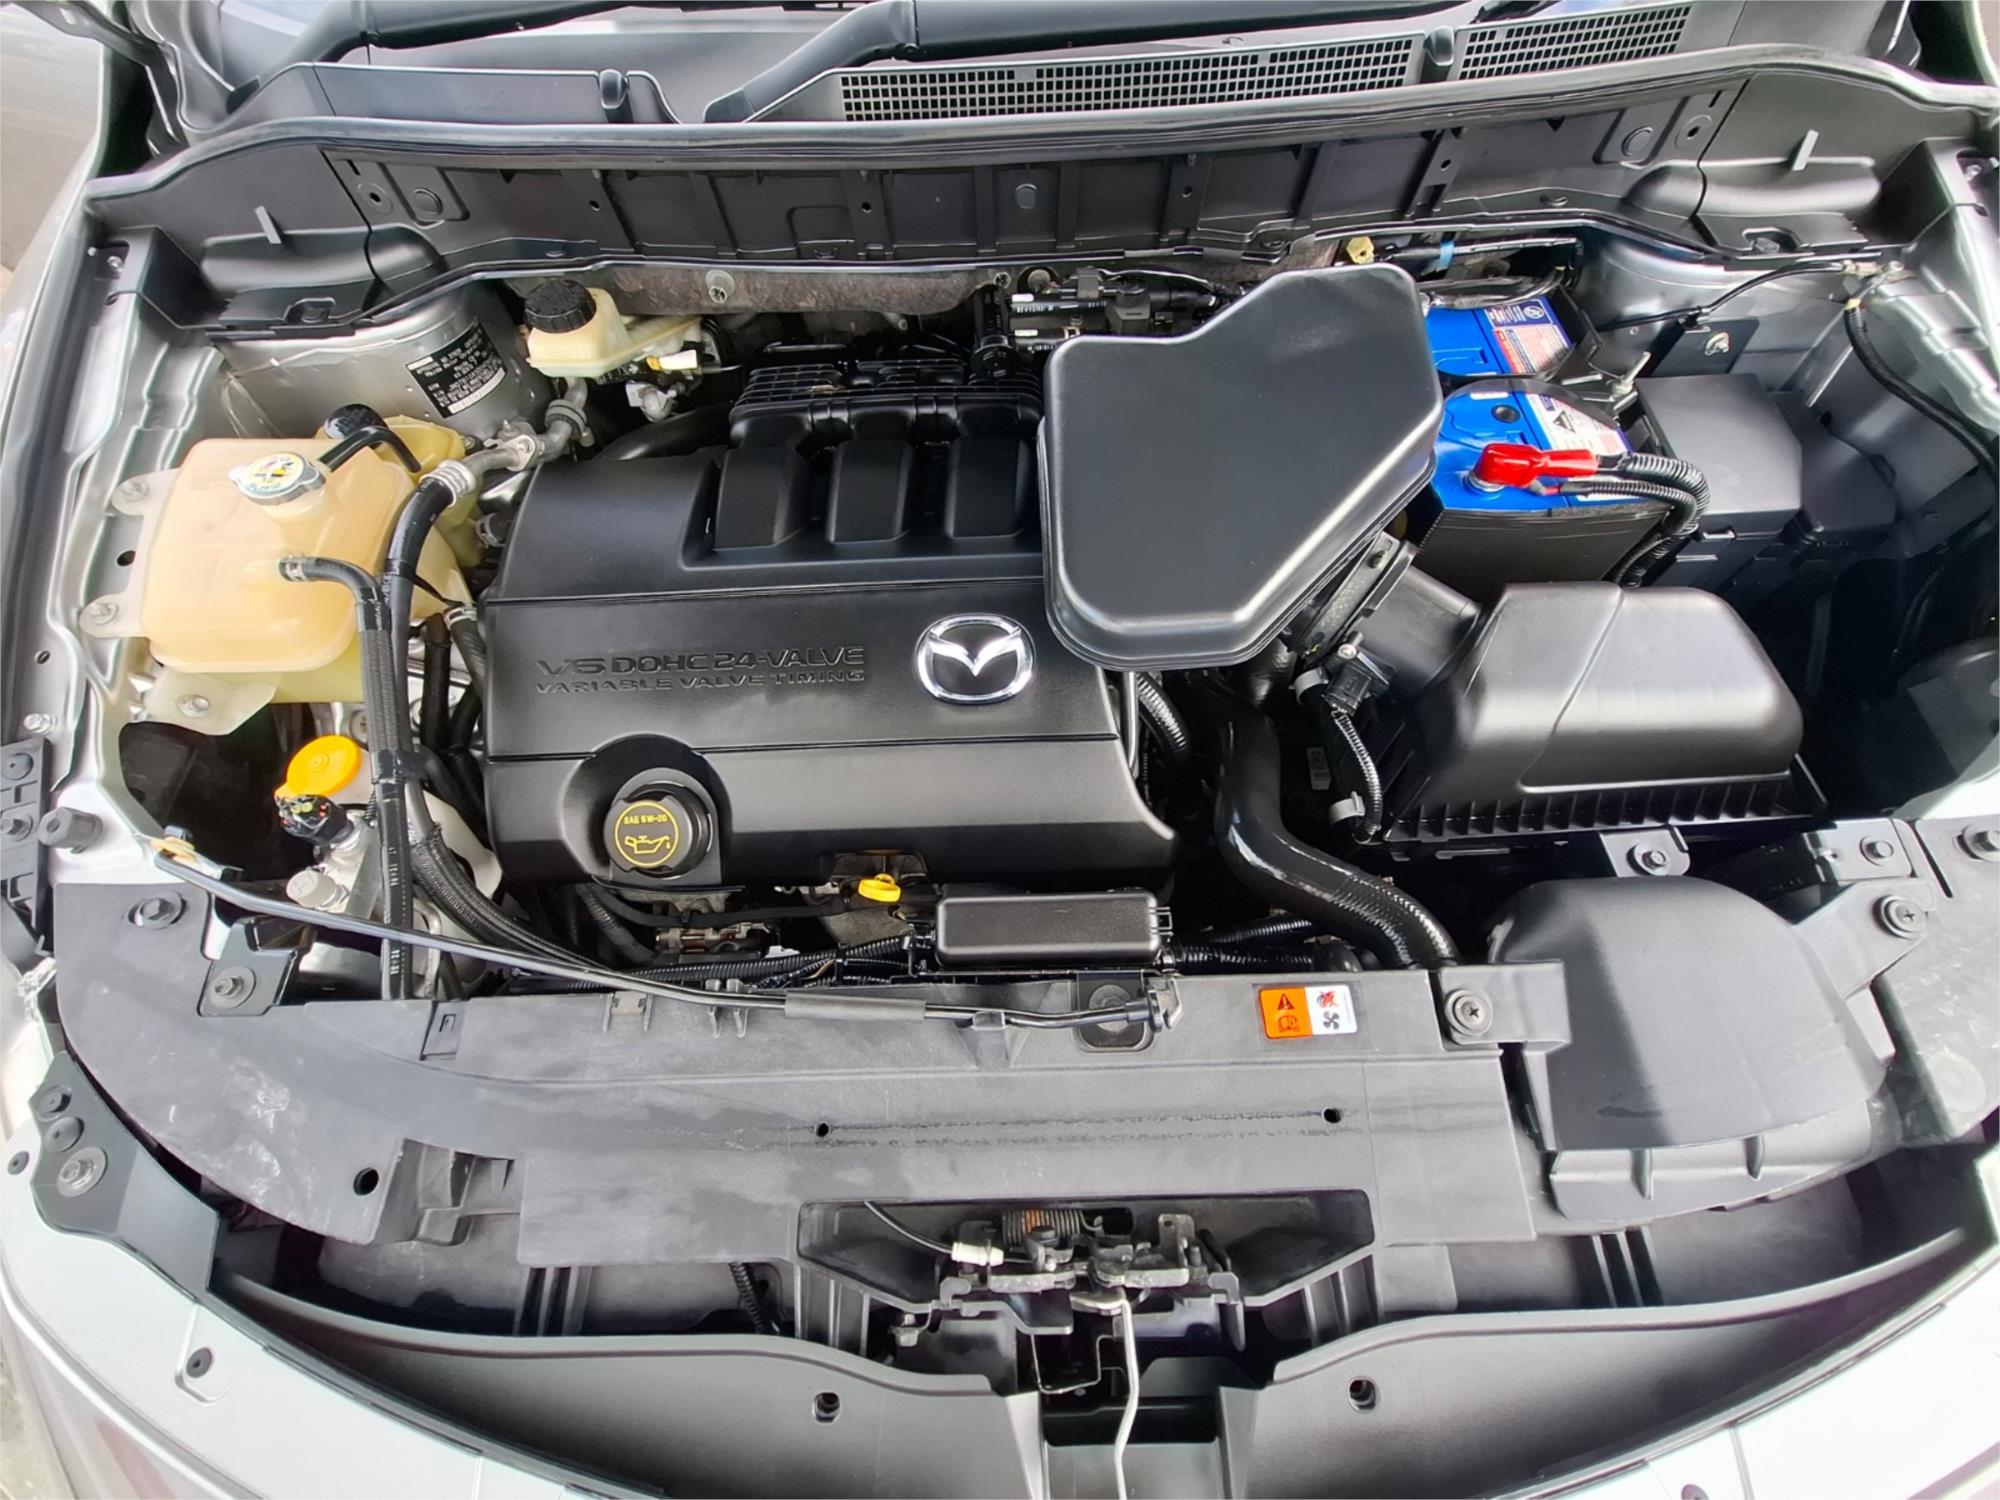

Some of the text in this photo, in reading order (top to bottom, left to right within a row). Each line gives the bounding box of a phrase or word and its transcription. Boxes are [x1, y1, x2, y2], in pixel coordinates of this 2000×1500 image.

[536, 645, 865, 677] V6 DOHC 24-VALVE
[535, 669, 865, 695] VARIABLE VALVE TIMING
[624, 814, 667, 825] SAE 5W-20
